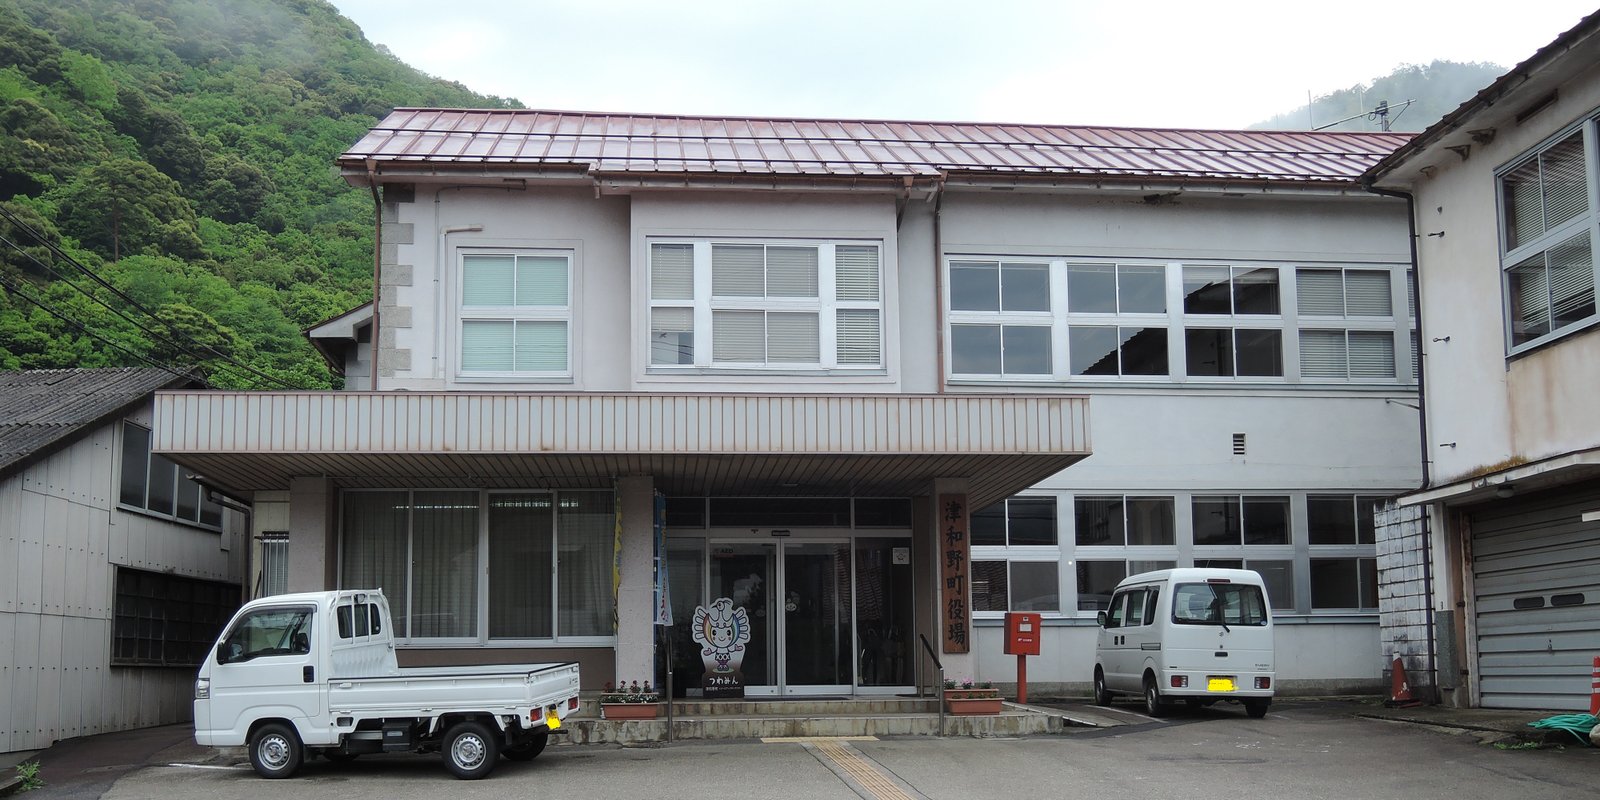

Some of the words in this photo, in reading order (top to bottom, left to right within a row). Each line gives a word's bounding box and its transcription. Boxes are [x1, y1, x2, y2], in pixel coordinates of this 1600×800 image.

[945, 501, 965, 645] 津和野町役場
[709, 676, 739, 685] つわみん
